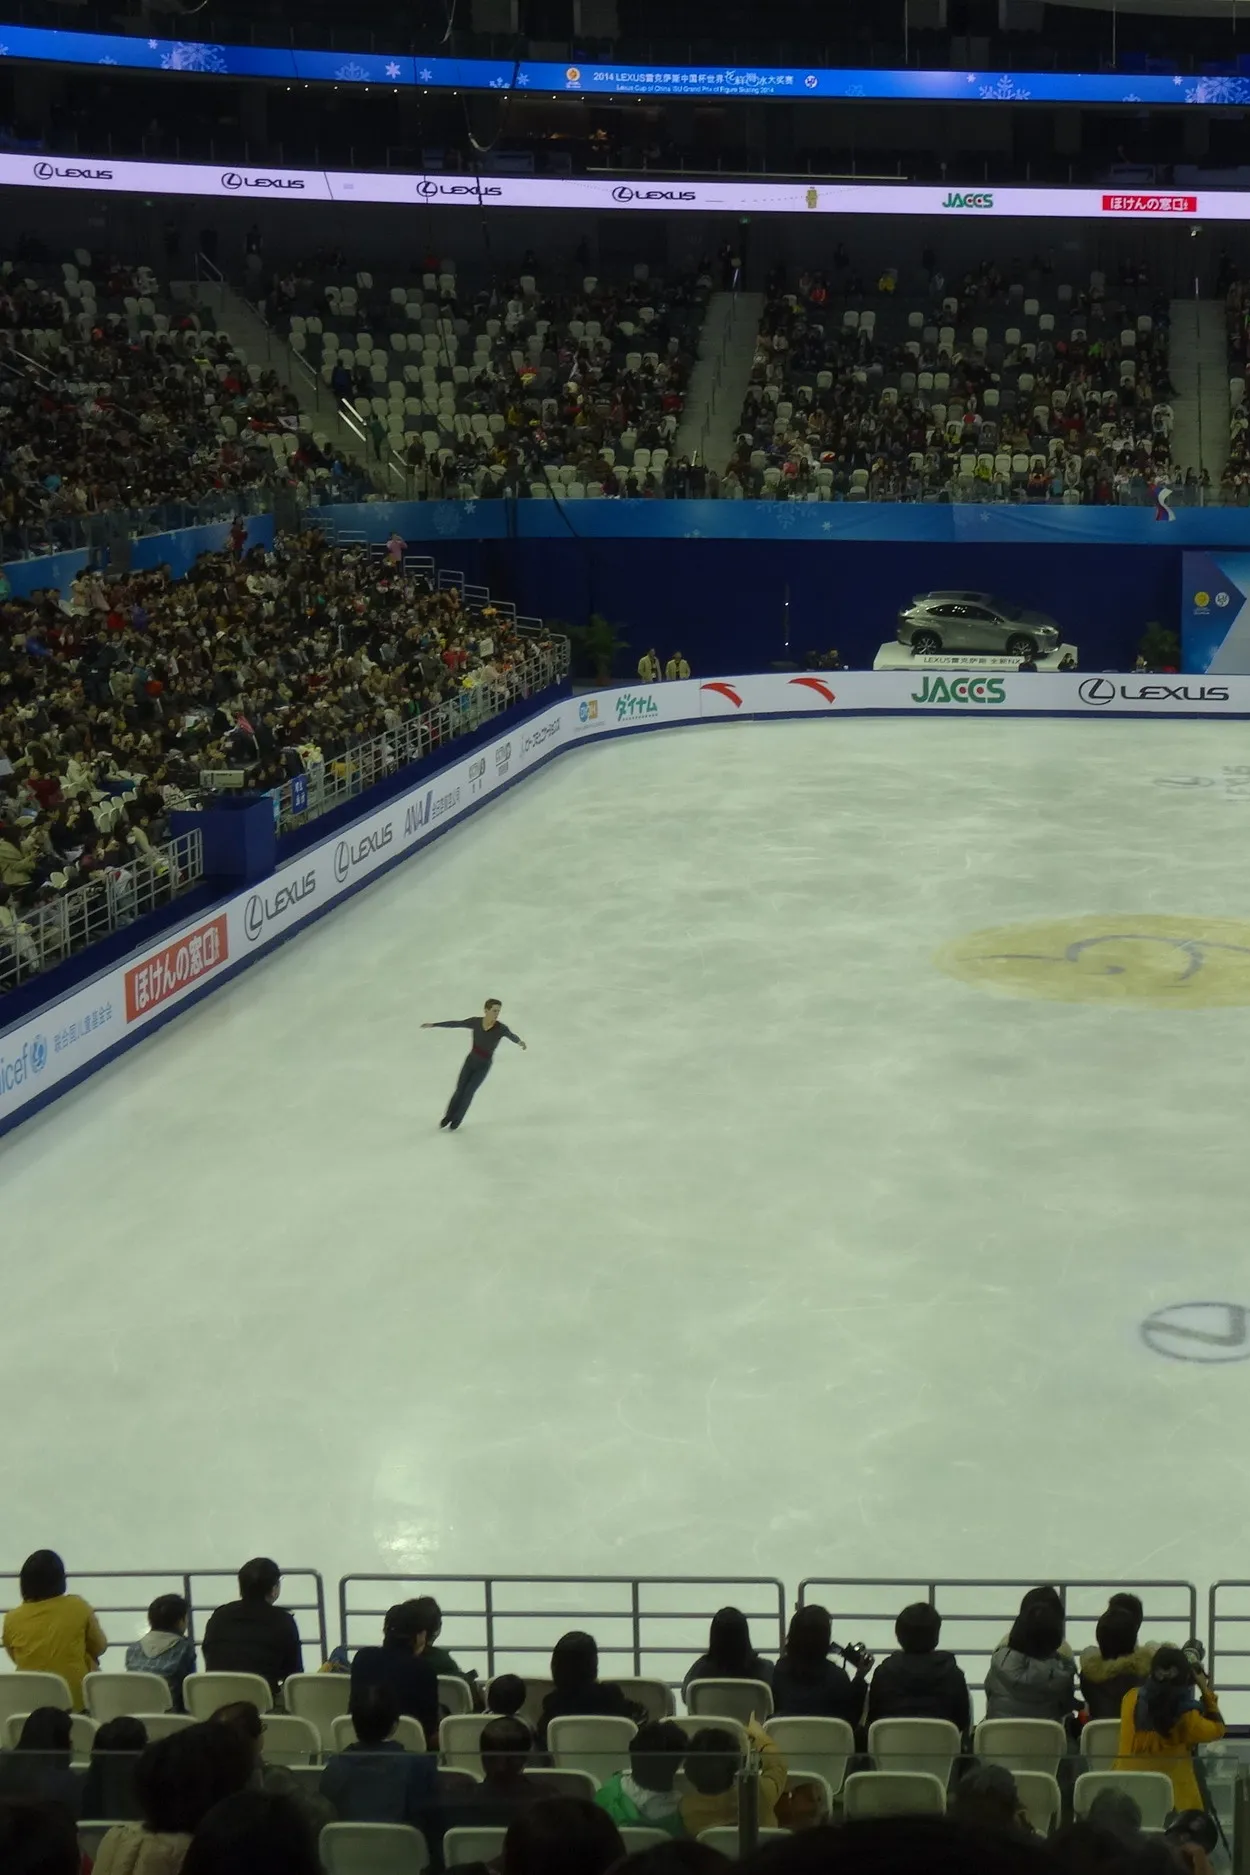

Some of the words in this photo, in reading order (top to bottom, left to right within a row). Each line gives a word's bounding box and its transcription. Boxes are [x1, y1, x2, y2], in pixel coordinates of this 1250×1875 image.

[593, 72, 614, 82] 2014
[634, 85, 648, 93] Cup
[720, 86, 737, 94] Figure
[55, 168, 113, 180] LEXUS
[244, 177, 305, 189] LEXUS
[440, 186, 502, 196] LEXUS
[636, 190, 696, 201] LEXUS
[942, 192, 993, 208] JACCS
[1110, 197, 1184, 211] ほけんの窓口
[911, 676, 1006, 704] JACCS
[1121, 686, 1229, 701] LEXUS
[616, 694, 657, 721] ダイナム
[404, 803, 426, 838] ANA
[351, 823, 392, 865] LEXUS
[266, 870, 316, 920] LEXUS
[135, 926, 215, 1011] ほけんの窓口
[0, 1042, 28, 1095] icef
